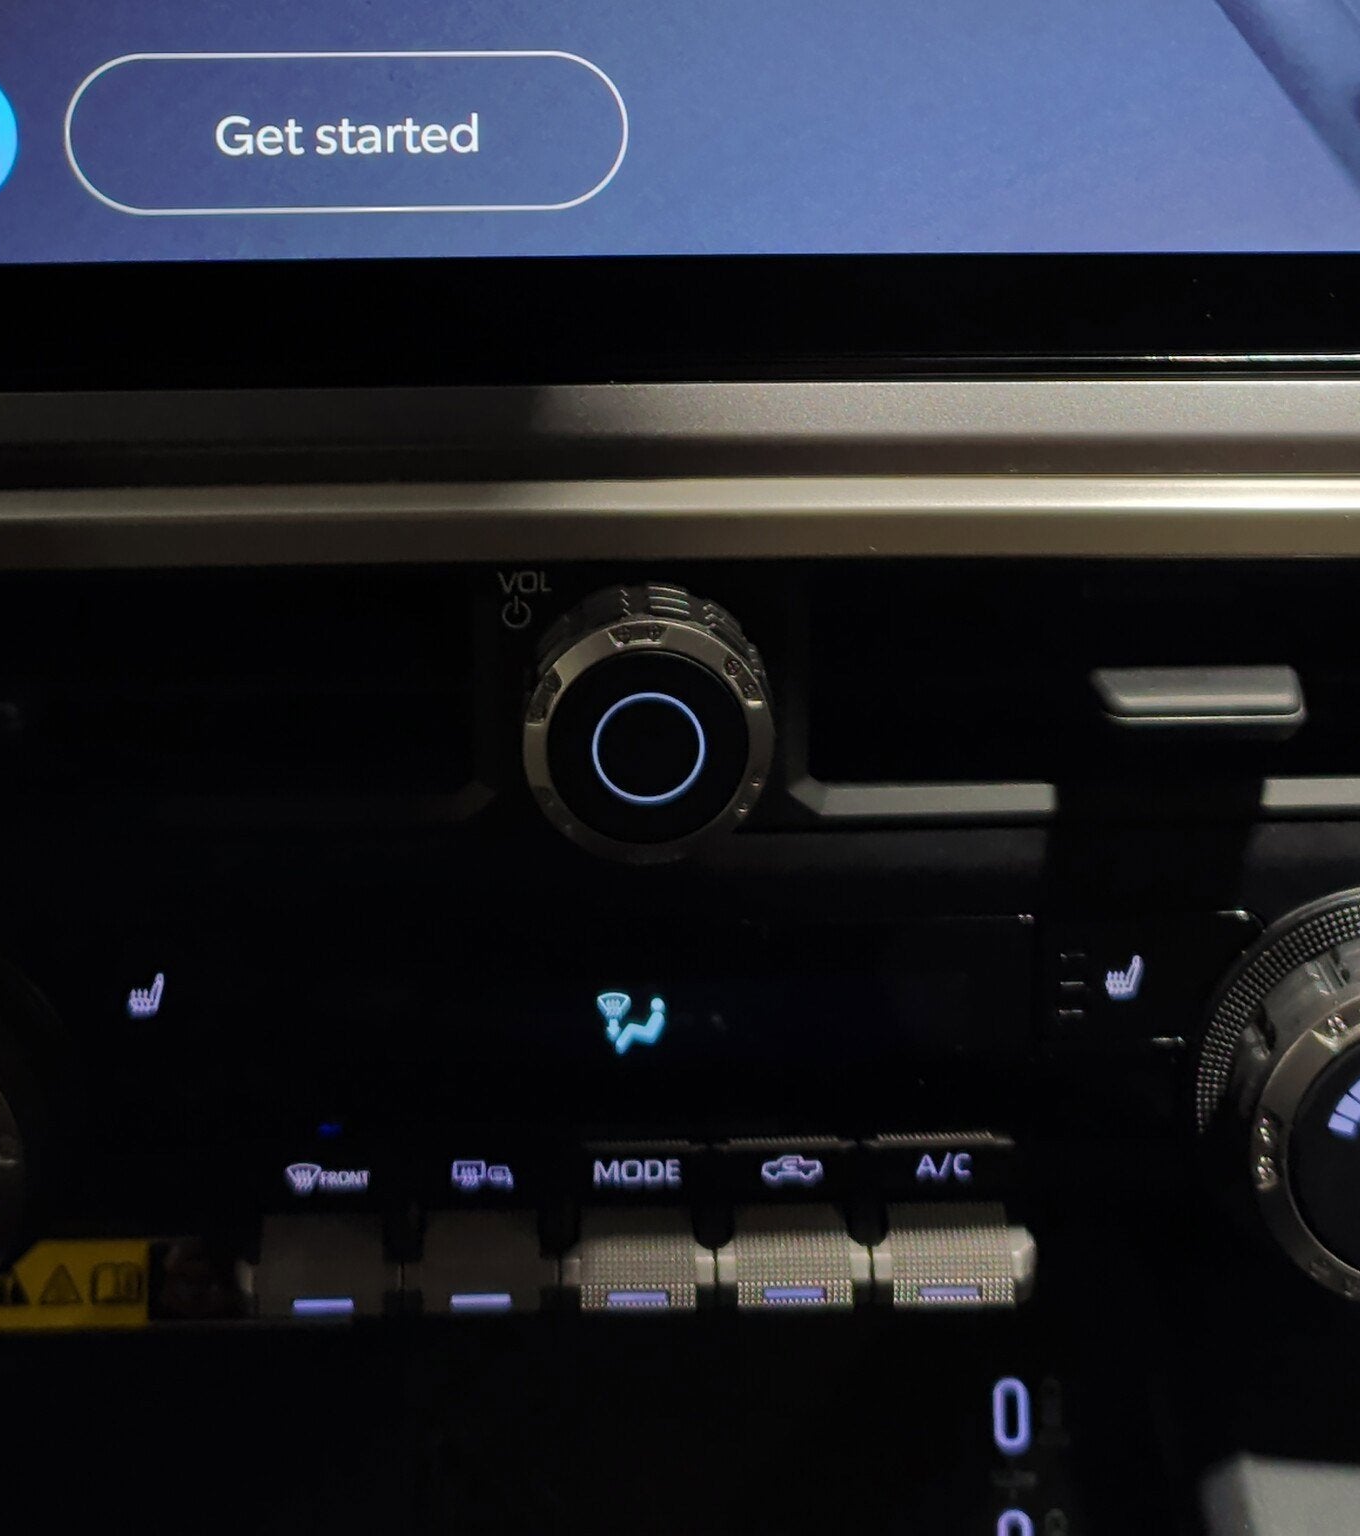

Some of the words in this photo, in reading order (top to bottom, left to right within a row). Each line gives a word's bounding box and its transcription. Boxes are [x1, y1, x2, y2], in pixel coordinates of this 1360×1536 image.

[215, 114, 303, 156] Get
[316, 112, 480, 156] started
[497, 571, 552, 595] VOL
[319, 1169, 371, 1190] FRONT
[593, 1159, 682, 1186] MODE
[916, 1152, 973, 1181] A/C
